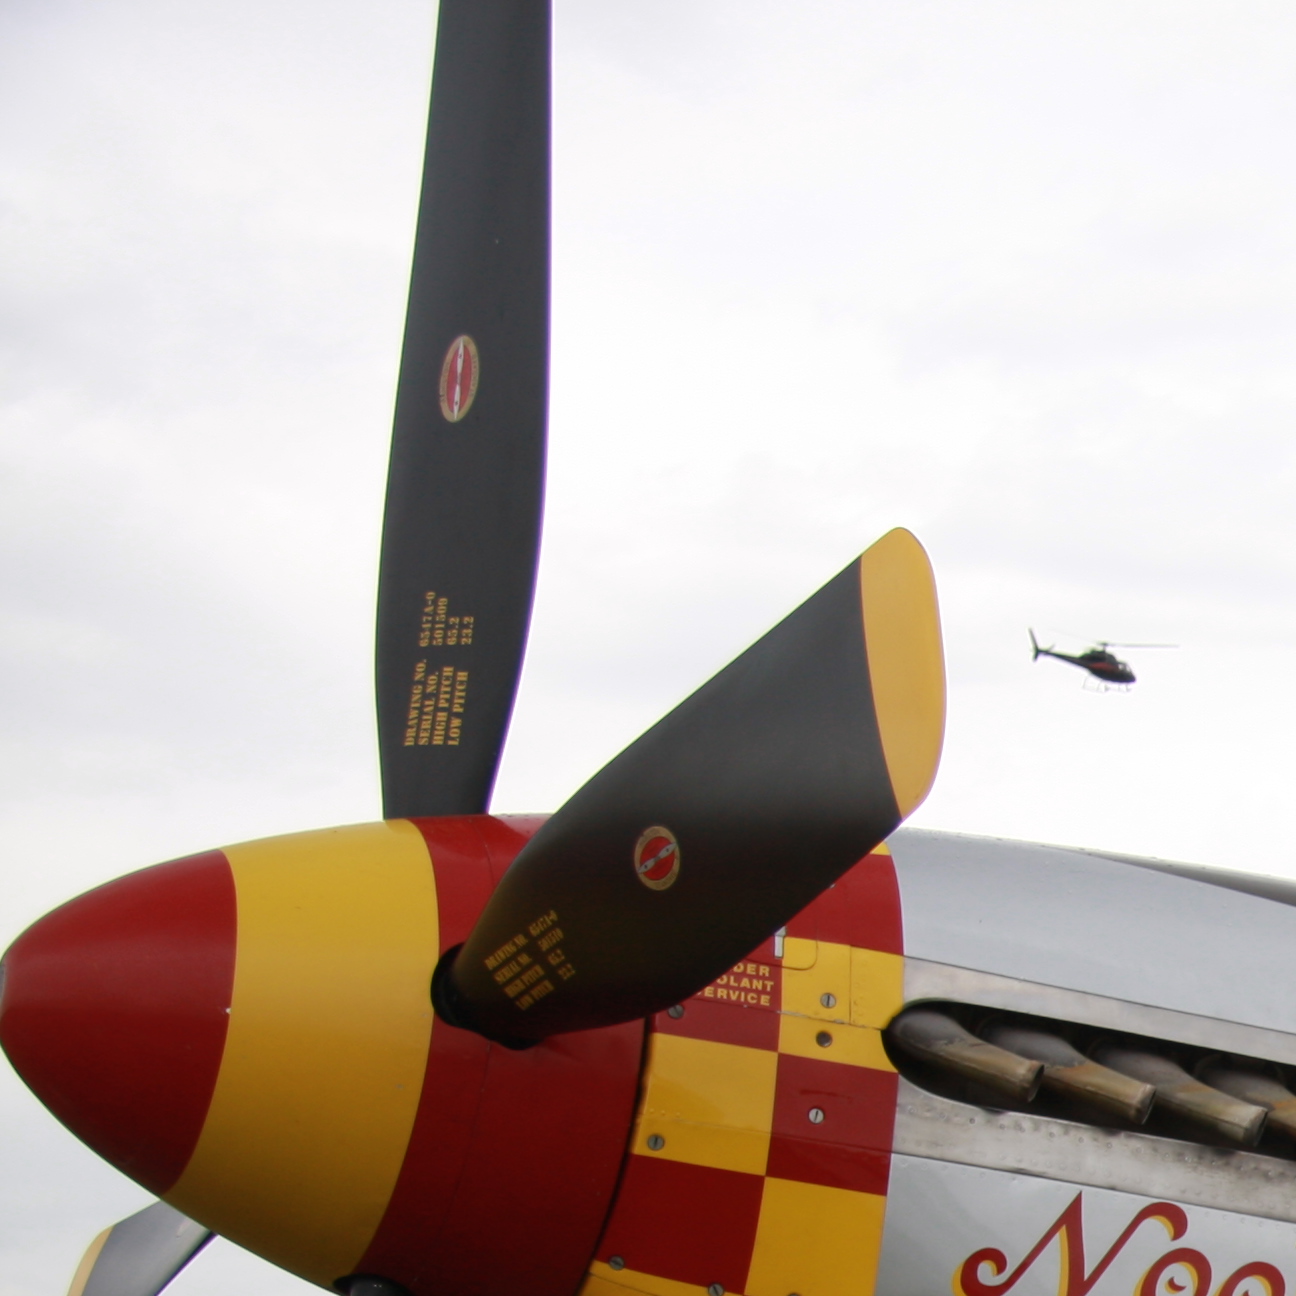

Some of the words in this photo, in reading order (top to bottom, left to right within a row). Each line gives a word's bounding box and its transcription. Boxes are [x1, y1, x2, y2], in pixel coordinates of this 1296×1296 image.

[446, 616, 460, 646] 65.2
[461, 616, 475, 645] 23.2
[426, 671, 439, 693] NO.
[438, 666, 454, 707] PITCH
[452, 671, 469, 713] PITCH
[404, 685, 423, 746] DRAWING
[414, 659, 427, 681] NO.
[418, 698, 435, 746] SERIAL
[432, 712, 448, 746] HIGH
[447, 716, 462, 746] LOW
[716, 975, 774, 991] OLANT
[733, 963, 770, 977] DER
[697, 987, 770, 1006] ERVICE
